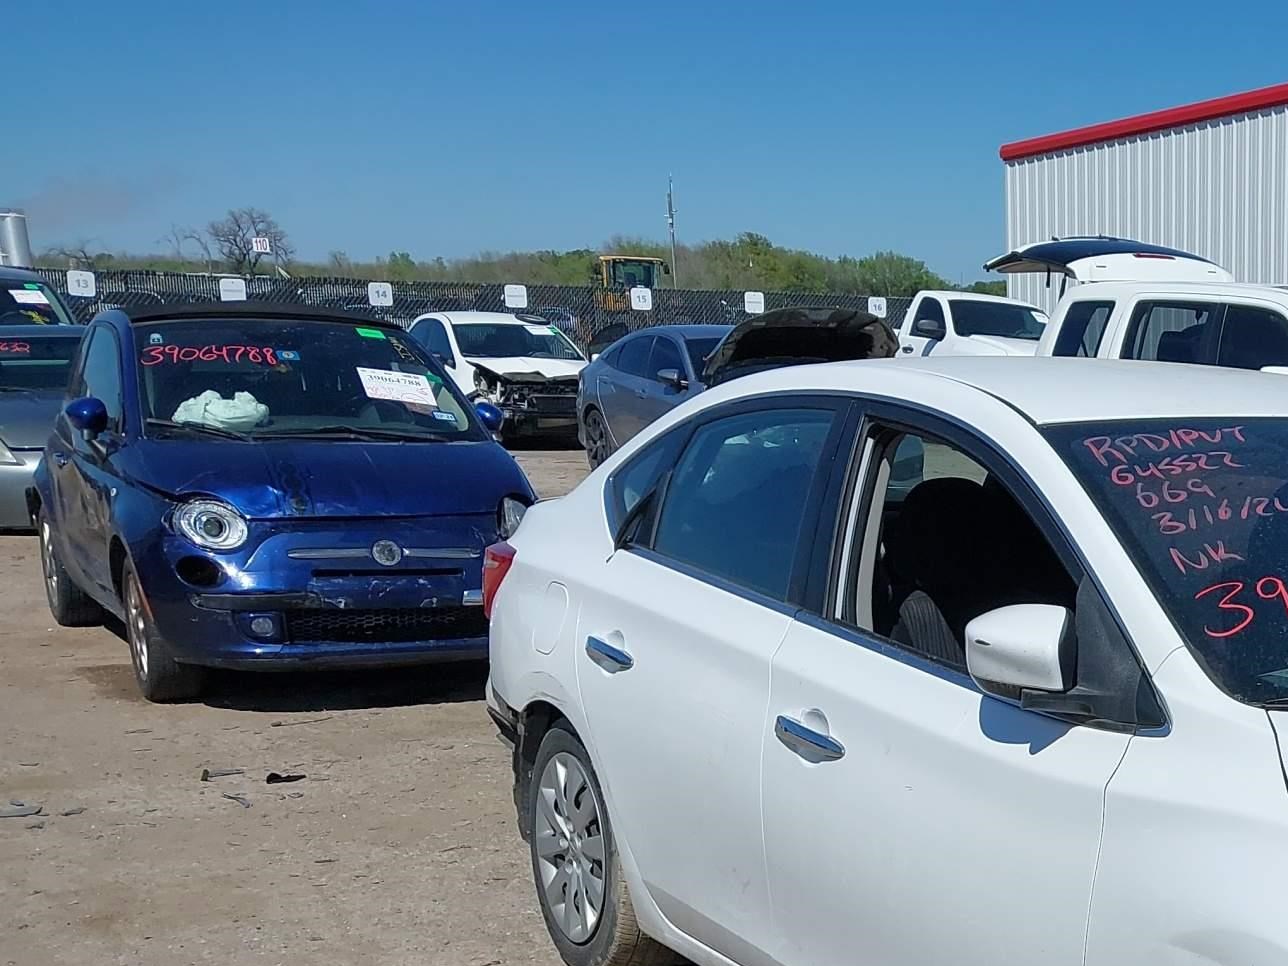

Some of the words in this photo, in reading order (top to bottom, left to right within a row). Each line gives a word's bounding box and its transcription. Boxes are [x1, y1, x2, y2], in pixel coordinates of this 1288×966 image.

[254, 238, 268, 251] 110
[75, 279, 89, 289] 13
[374, 289, 388, 299] 14
[636, 295, 648, 304] 15
[873, 303, 883, 312] 16
[140, 344, 278, 366] 39064788
